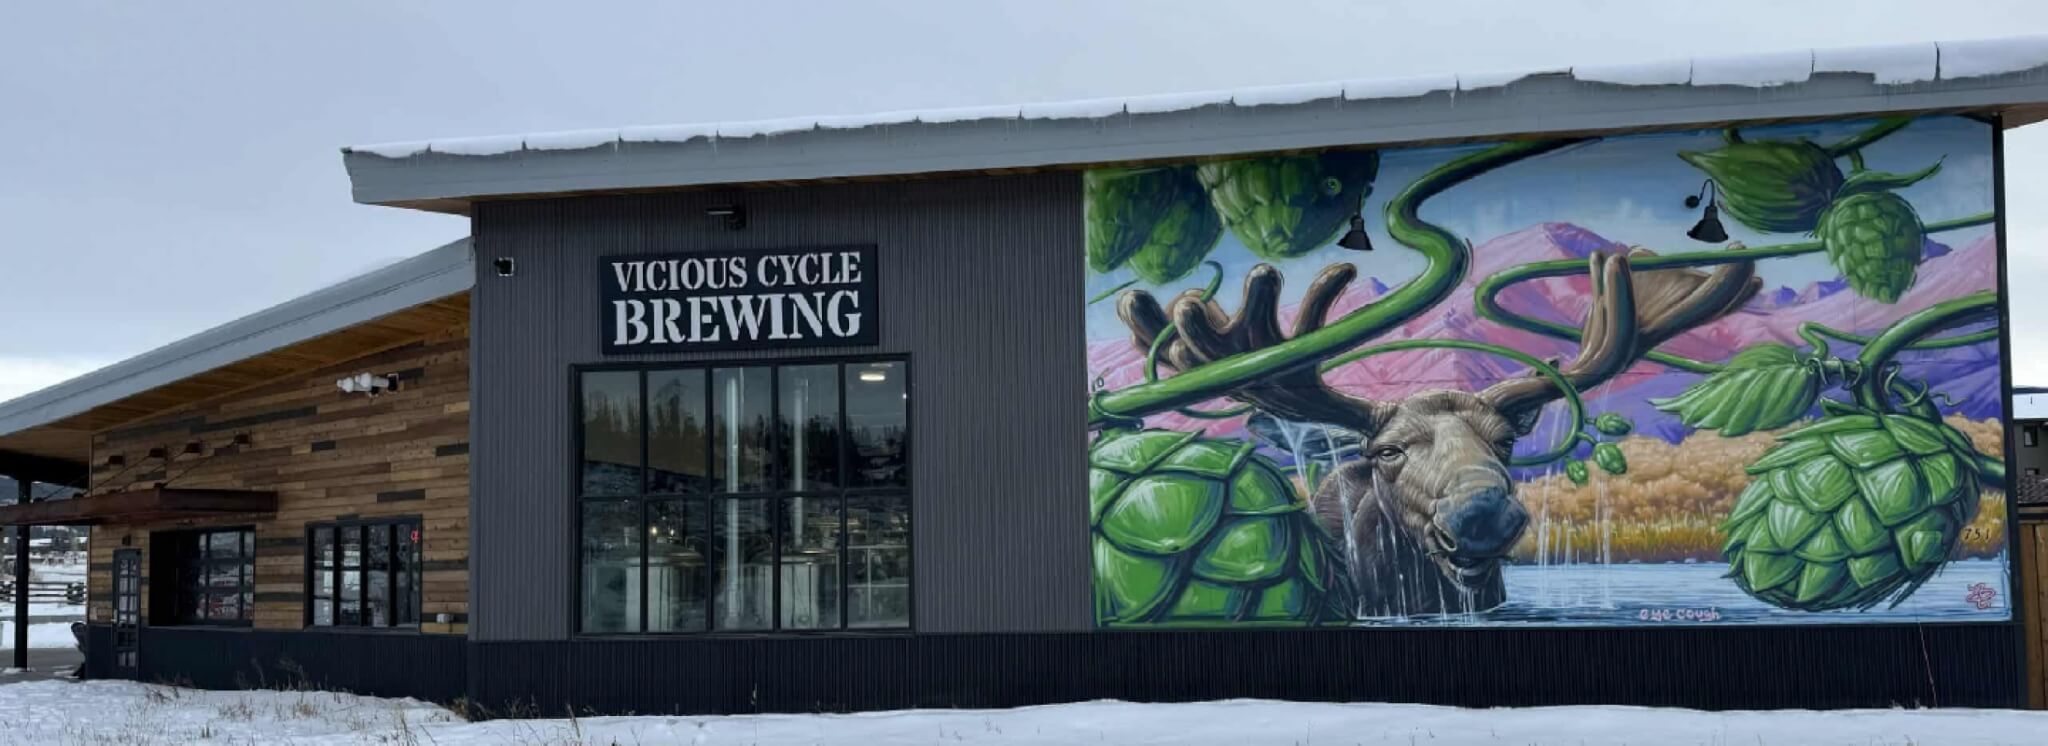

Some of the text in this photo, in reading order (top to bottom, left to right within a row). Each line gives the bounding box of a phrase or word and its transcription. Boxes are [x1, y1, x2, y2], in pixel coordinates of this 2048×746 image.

[612, 251, 862, 292] VICIOUS CYCLE
[612, 290, 862, 345] BREWING
